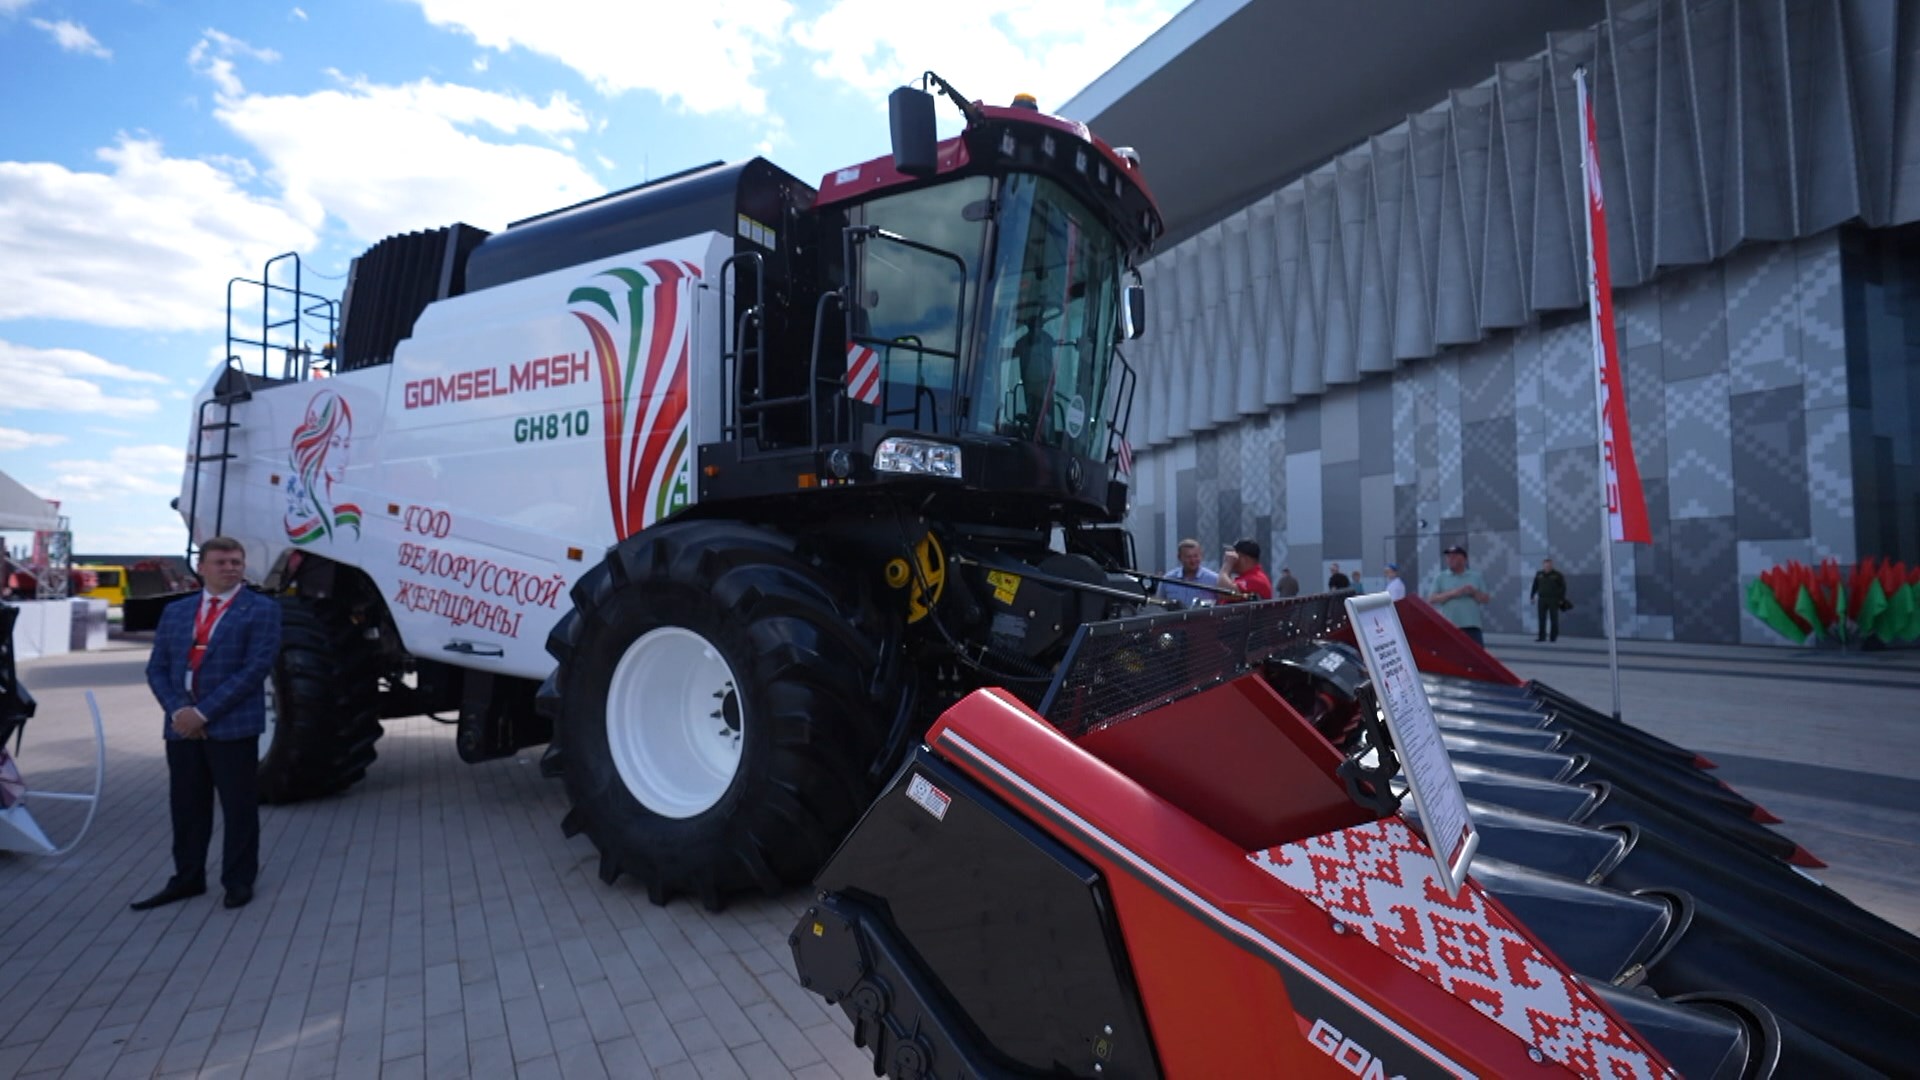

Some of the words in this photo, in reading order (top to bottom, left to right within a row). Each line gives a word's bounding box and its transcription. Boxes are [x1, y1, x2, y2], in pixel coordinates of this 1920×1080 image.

[405, 350, 590, 410] GOMSELMASH
[514, 409, 589, 443] GH810
[404, 505, 450, 538] ГОД
[398, 543, 566, 609] БЕЛОРУССКОЙ
[394, 579, 523, 638] ЖЕНЩИНЫ
